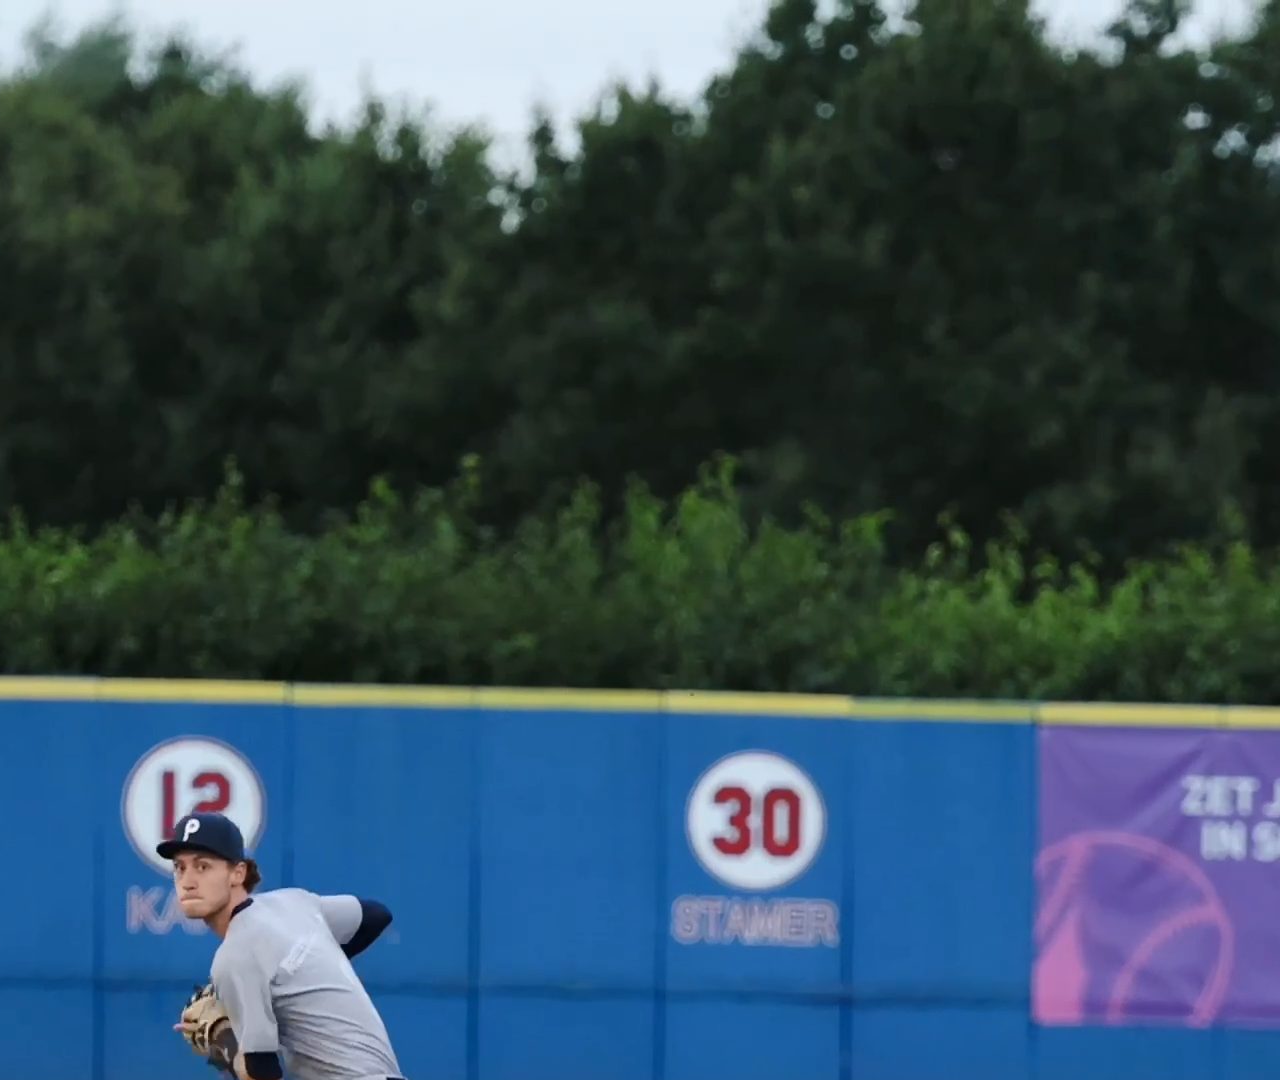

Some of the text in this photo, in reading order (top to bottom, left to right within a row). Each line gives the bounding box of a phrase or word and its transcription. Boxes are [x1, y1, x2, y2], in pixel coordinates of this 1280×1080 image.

[162, 770, 231, 842] 12
[712, 786, 802, 858] 30
[1180, 775, 1261, 817] ZET
[1200, 819, 1248, 862] IN
[671, 894, 841, 948] STAMER
